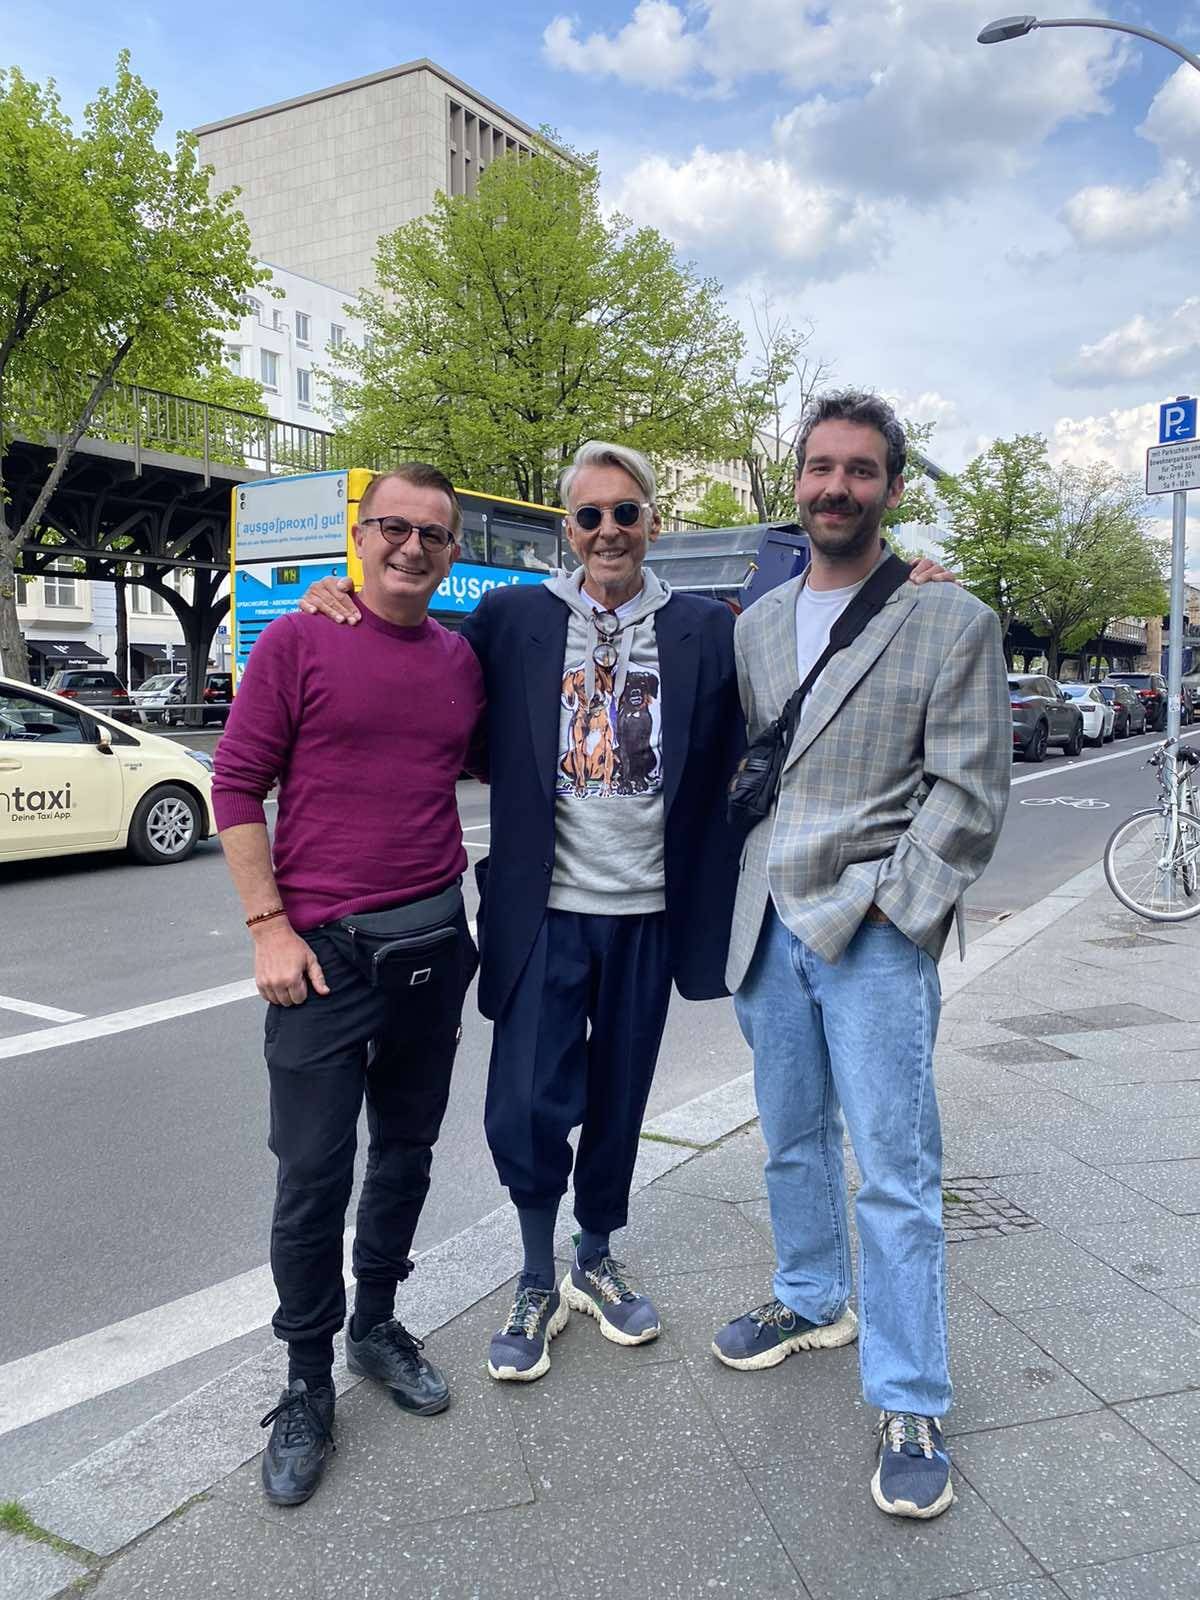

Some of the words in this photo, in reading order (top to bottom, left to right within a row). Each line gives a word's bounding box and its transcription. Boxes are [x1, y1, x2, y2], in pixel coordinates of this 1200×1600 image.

[1165, 406, 1186, 438] P
[321, 511, 344, 530] gut!
[11, 814, 35, 822] Deine
[37, 811, 53, 820] Taxi
